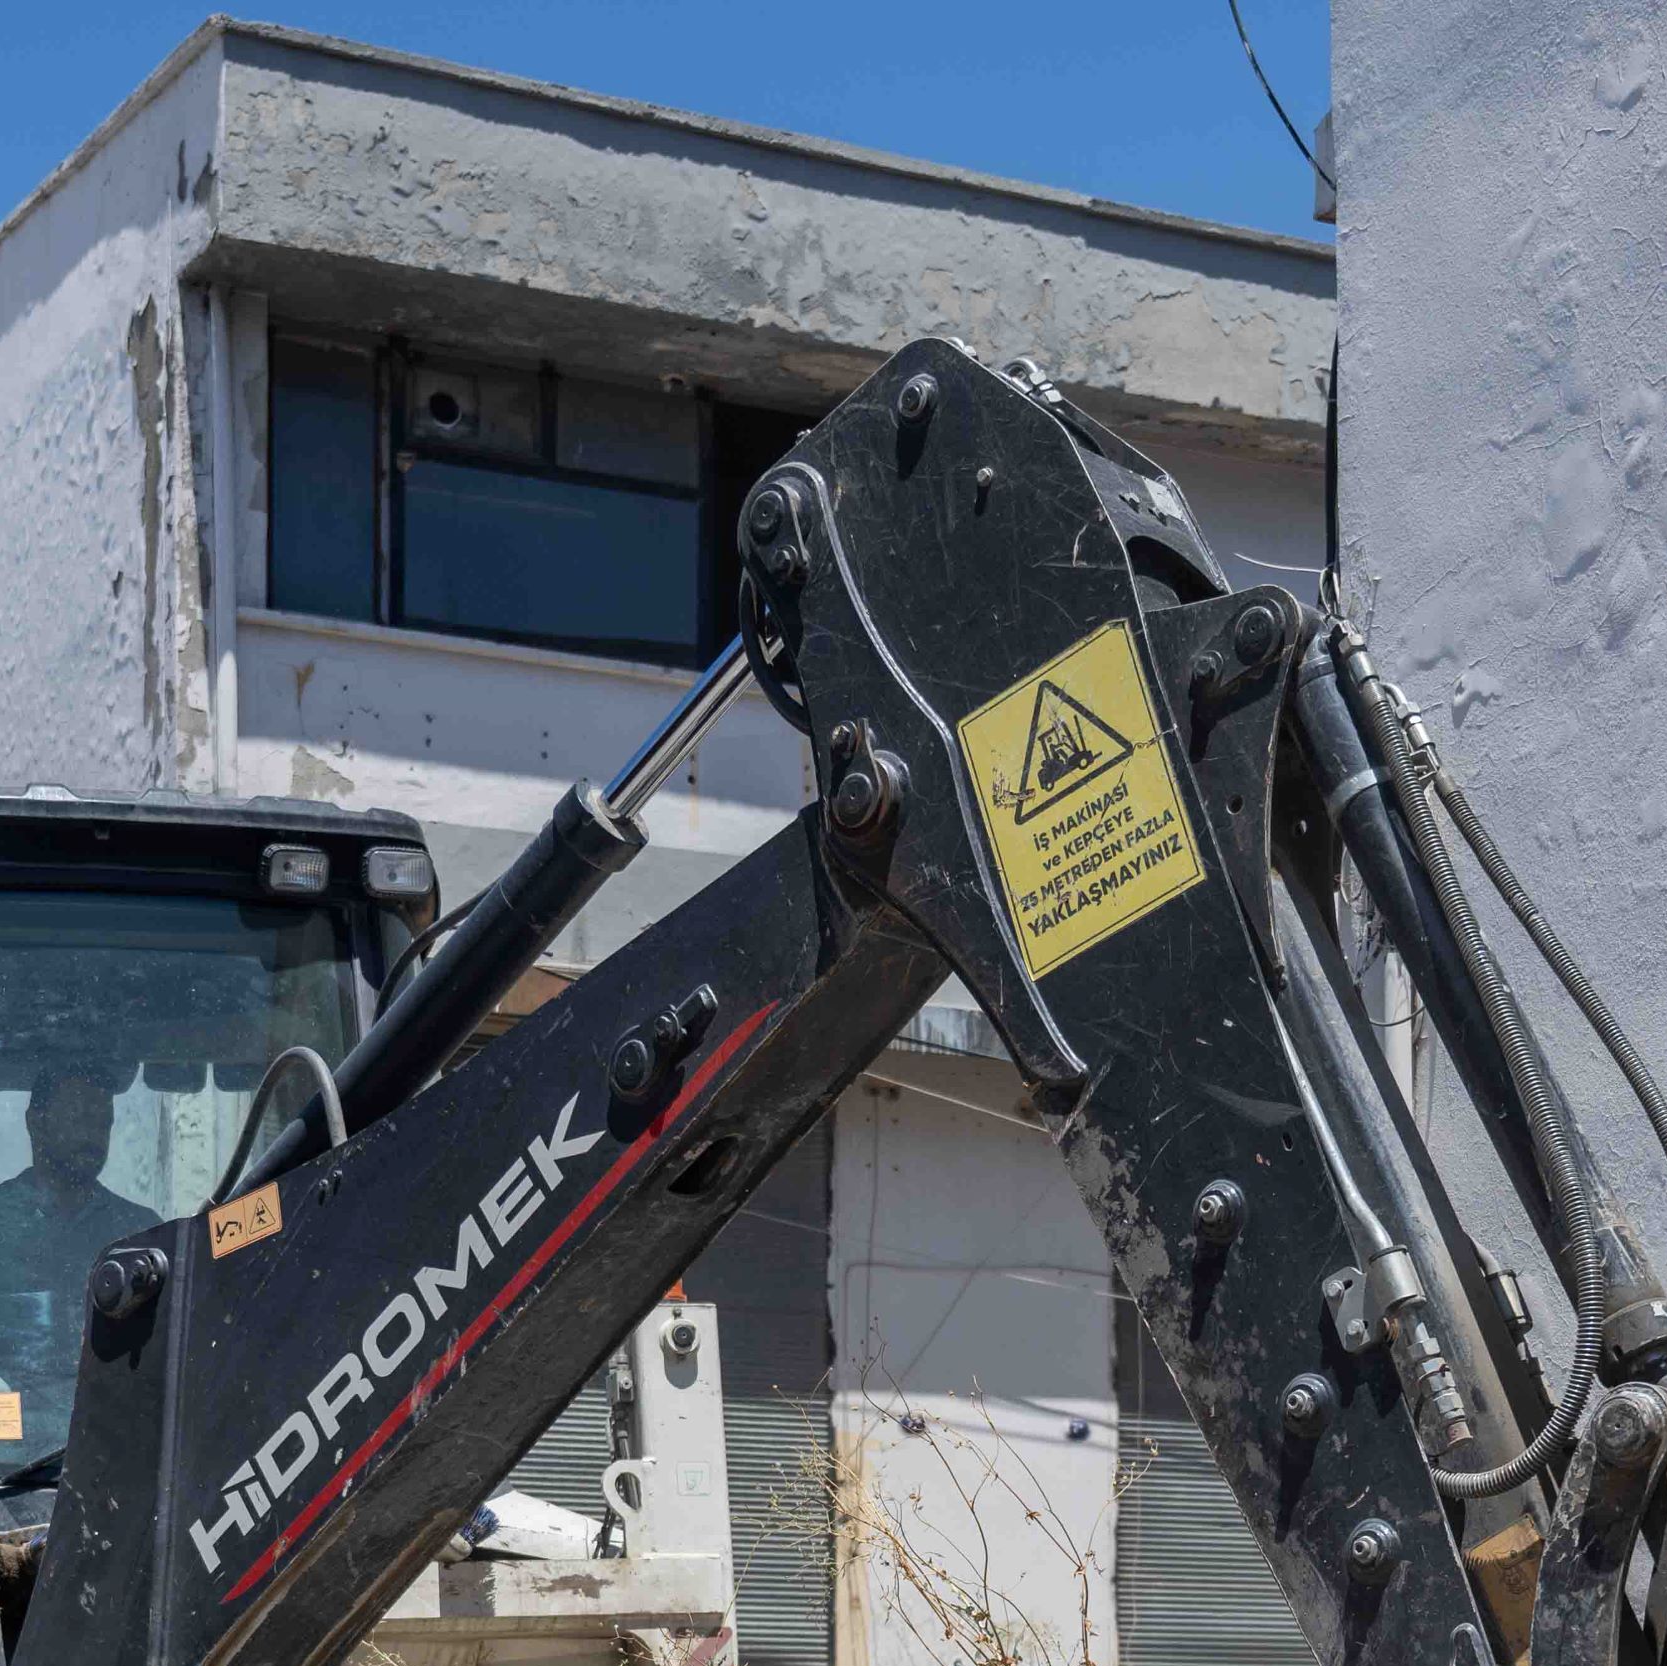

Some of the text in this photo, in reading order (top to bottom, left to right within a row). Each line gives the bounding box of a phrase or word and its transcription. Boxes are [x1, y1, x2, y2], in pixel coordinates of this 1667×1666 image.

[1033, 783, 1129, 852] İŞ MAKİNASI
[1040, 839, 1123, 900] METREDEN
[1124, 808, 1175, 848] FAZLA
[1042, 806, 1134, 872] ve KEPÇEYE
[1027, 832, 1183, 938] YAKLAŞMAYINIZ
